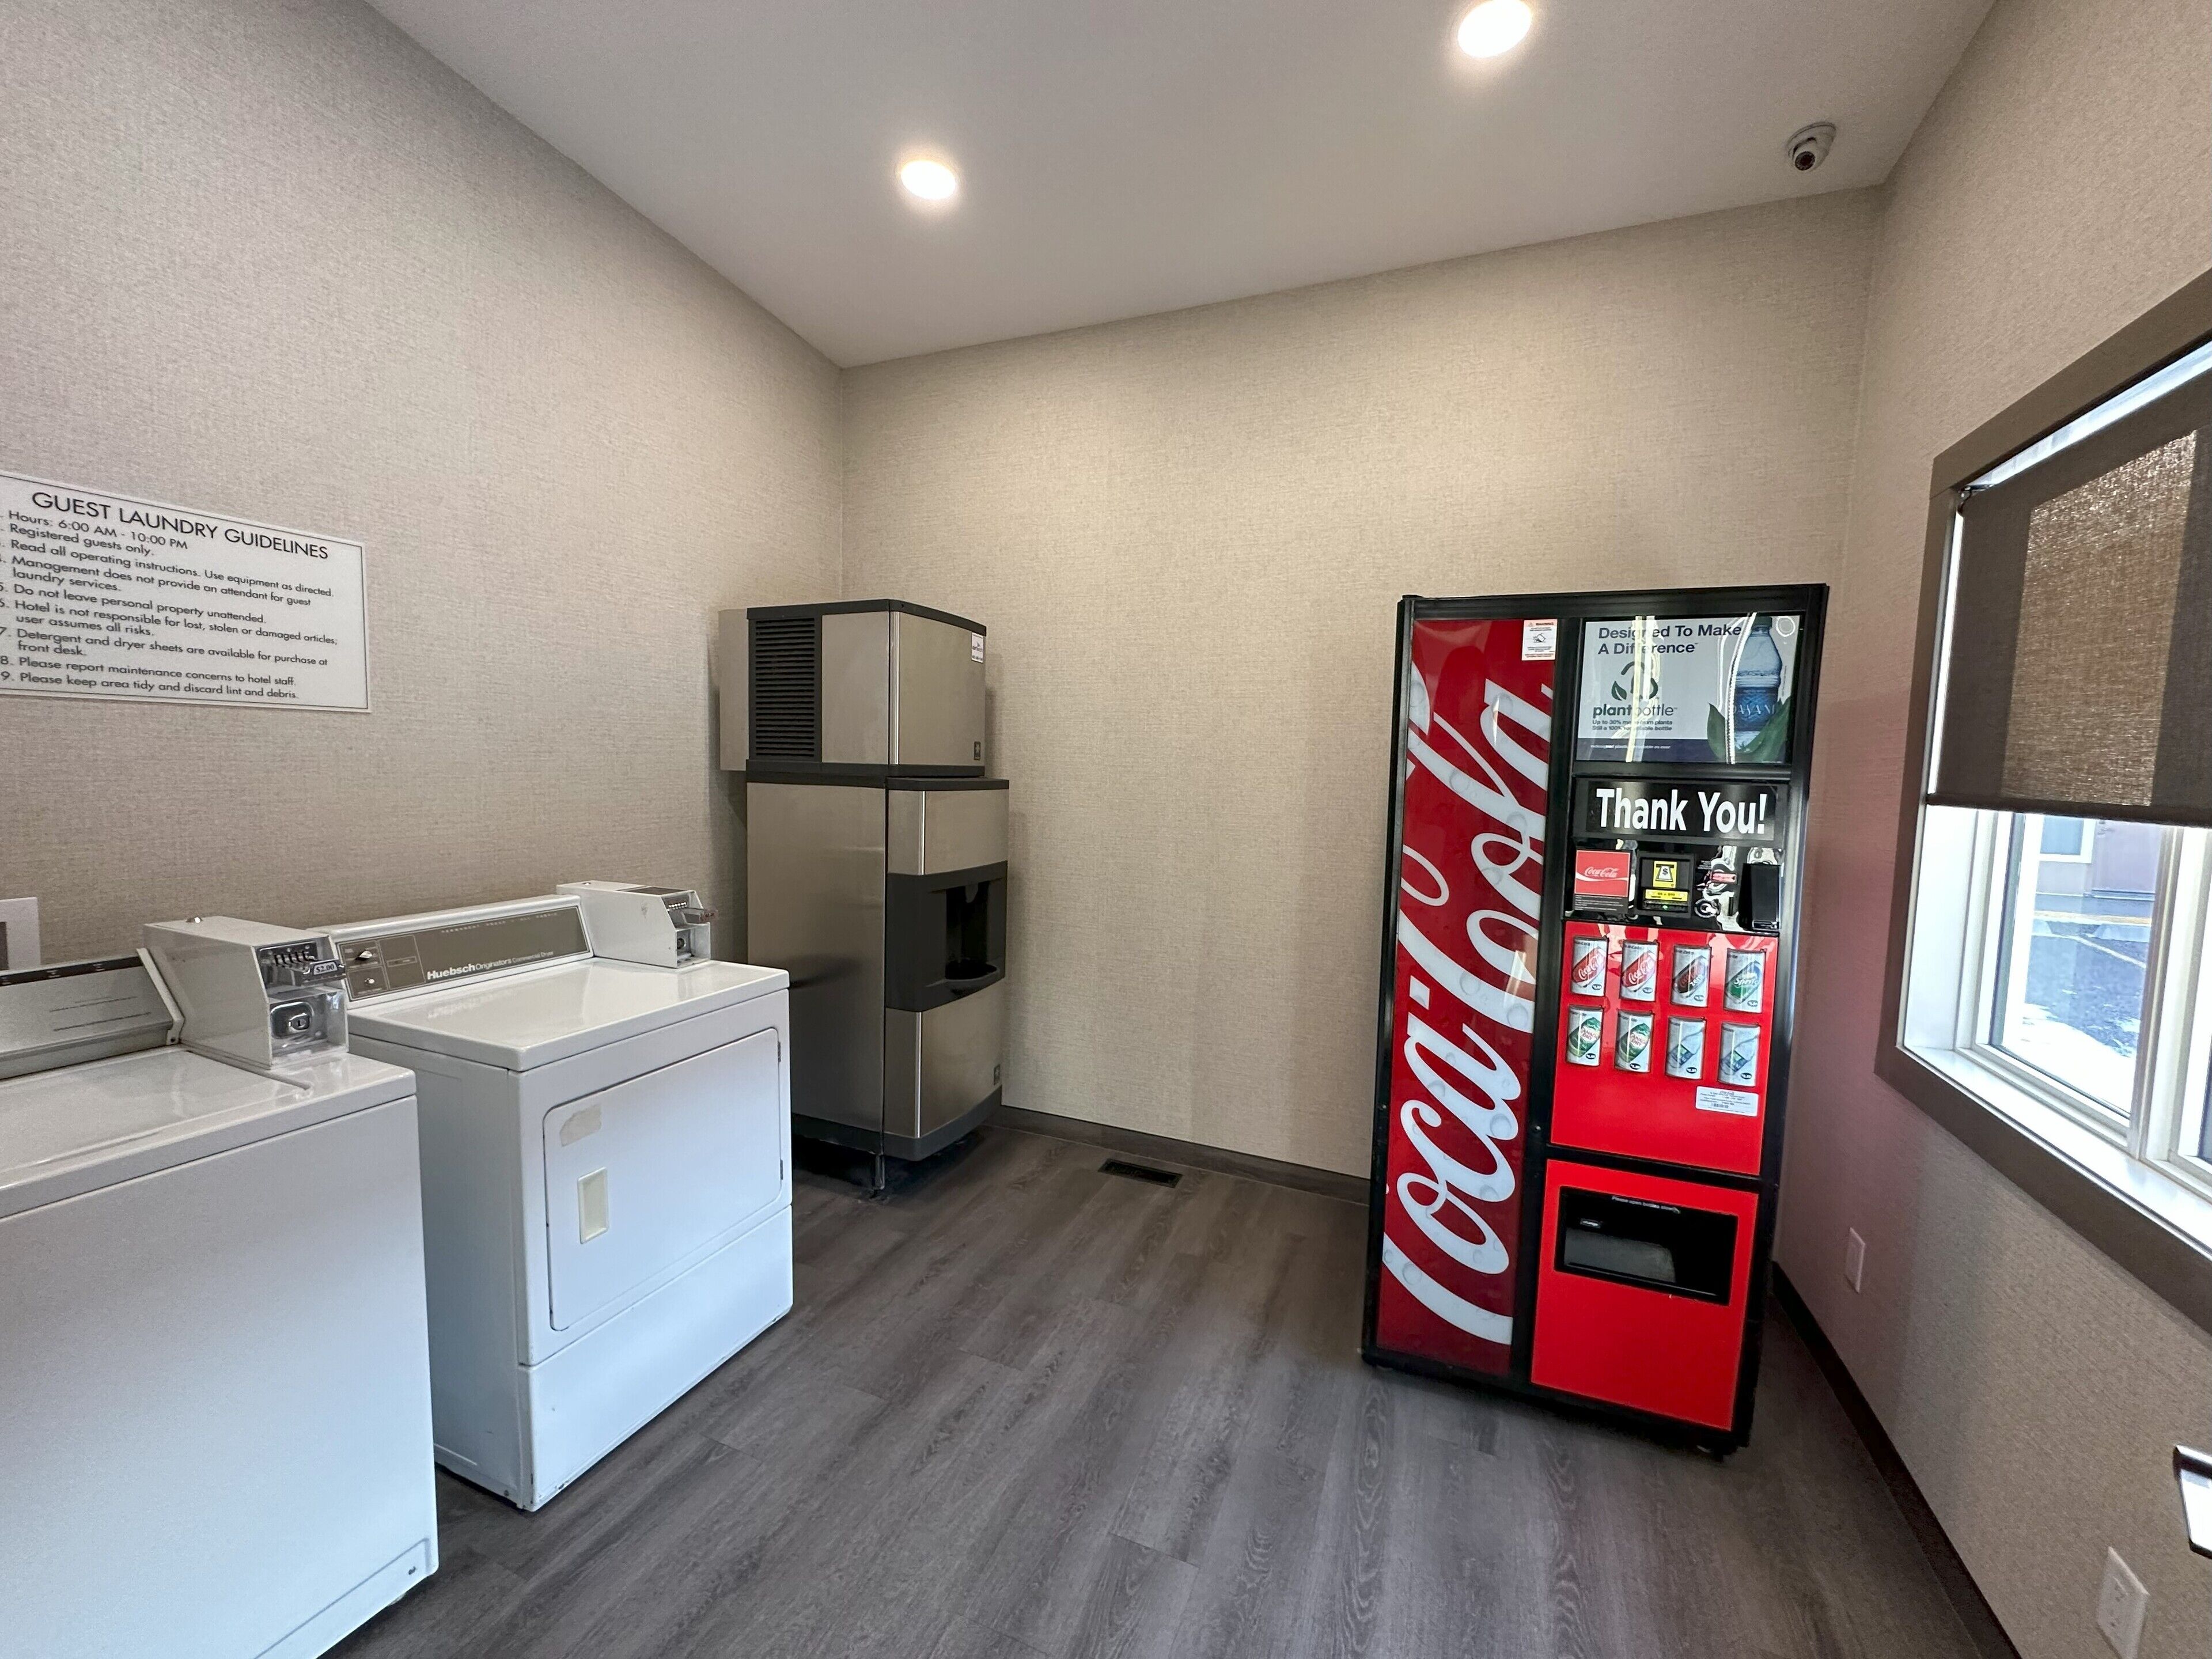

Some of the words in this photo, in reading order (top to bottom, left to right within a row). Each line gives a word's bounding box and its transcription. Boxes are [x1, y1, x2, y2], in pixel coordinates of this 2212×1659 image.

[9, 510, 52, 526] Hours:
[59, 520, 89, 532] 6:00
[94, 527, 117, 537] AM
[131, 532, 165, 545] 10:00
[170, 539, 188, 549] PM
[10, 524, 79, 543] Registered
[84, 539, 122, 550] guests
[126, 544, 154, 556] only.
[32, 493, 111, 518] GUEST
[119, 507, 217, 539] LAUNDRY
[225, 529, 328, 559] GUIDELINES
[11, 539, 46, 553] Read
[51, 546, 66, 556] all
[71, 551, 131, 569] operating
[135, 559, 200, 577] instructions.
[205, 570, 224, 580] Use
[228, 575, 279, 588] equipment
[296, 584, 334, 597] directed.
[12, 555, 99, 575] Management
[104, 569, 132, 581] does
[158, 579, 200, 590] provide
[221, 587, 267, 600] attendant
[271, 592, 283, 601] for
[13, 567, 65, 585] laundry
[70, 578, 122, 591] services.
[14, 584, 33, 595] Do
[39, 590, 59, 598] not
[65, 589, 97, 603] leave
[101, 597, 153, 609] personal
[157, 605, 203, 617] property
[207, 611, 267, 623] unattended.
[15, 600, 49, 612] Hotel
[55, 605, 65, 613] is
[94, 611, 161, 625] responsible
[165, 616, 180, 626] for
[184, 619, 205, 631] lost,
[210, 623, 238, 633] stolen
[256, 627, 301, 641] damaged
[304, 635, 338, 645] articles;
[49, 618, 102, 630] assumes
[106, 623, 120, 632] all
[126, 625, 154, 635] risks.
[1675, 625, 1692, 637] To
[1699, 624, 1742, 636] Make
[18, 628, 82, 644] Detergent
[86, 636, 109, 646] and
[114, 637, 145, 650] dryer
[150, 641, 183, 652] sheets
[187, 646, 204, 654] are
[208, 648, 255, 659] available
[258, 651, 271, 660] for
[275, 654, 316, 664] purchase
[18, 640, 49, 652] front
[54, 645, 86, 656] desk.
[1598, 644, 1609, 654] A
[0, 656, 13, 665] 8.
[20, 657, 61, 669] Please
[66, 663, 104, 672] report
[108, 665, 183, 677] maintenance
[186, 672, 232, 681] concerns
[248, 674, 271, 683] hotel
[275, 677, 296, 685] staff.
[1, 671, 14, 681] 9.
[20, 673, 62, 684] Please
[67, 675, 97, 688] keep
[134, 680, 154, 691] tidy
[159, 682, 180, 691] and
[184, 683, 222, 694] discard
[227, 685, 241, 695] lint
[245, 688, 263, 696] and
[267, 688, 300, 699] debris.
[1596, 787, 1688, 831] Thank
[1698, 792, 1767, 835] You!
[317, 963, 335, 973] $2.00
